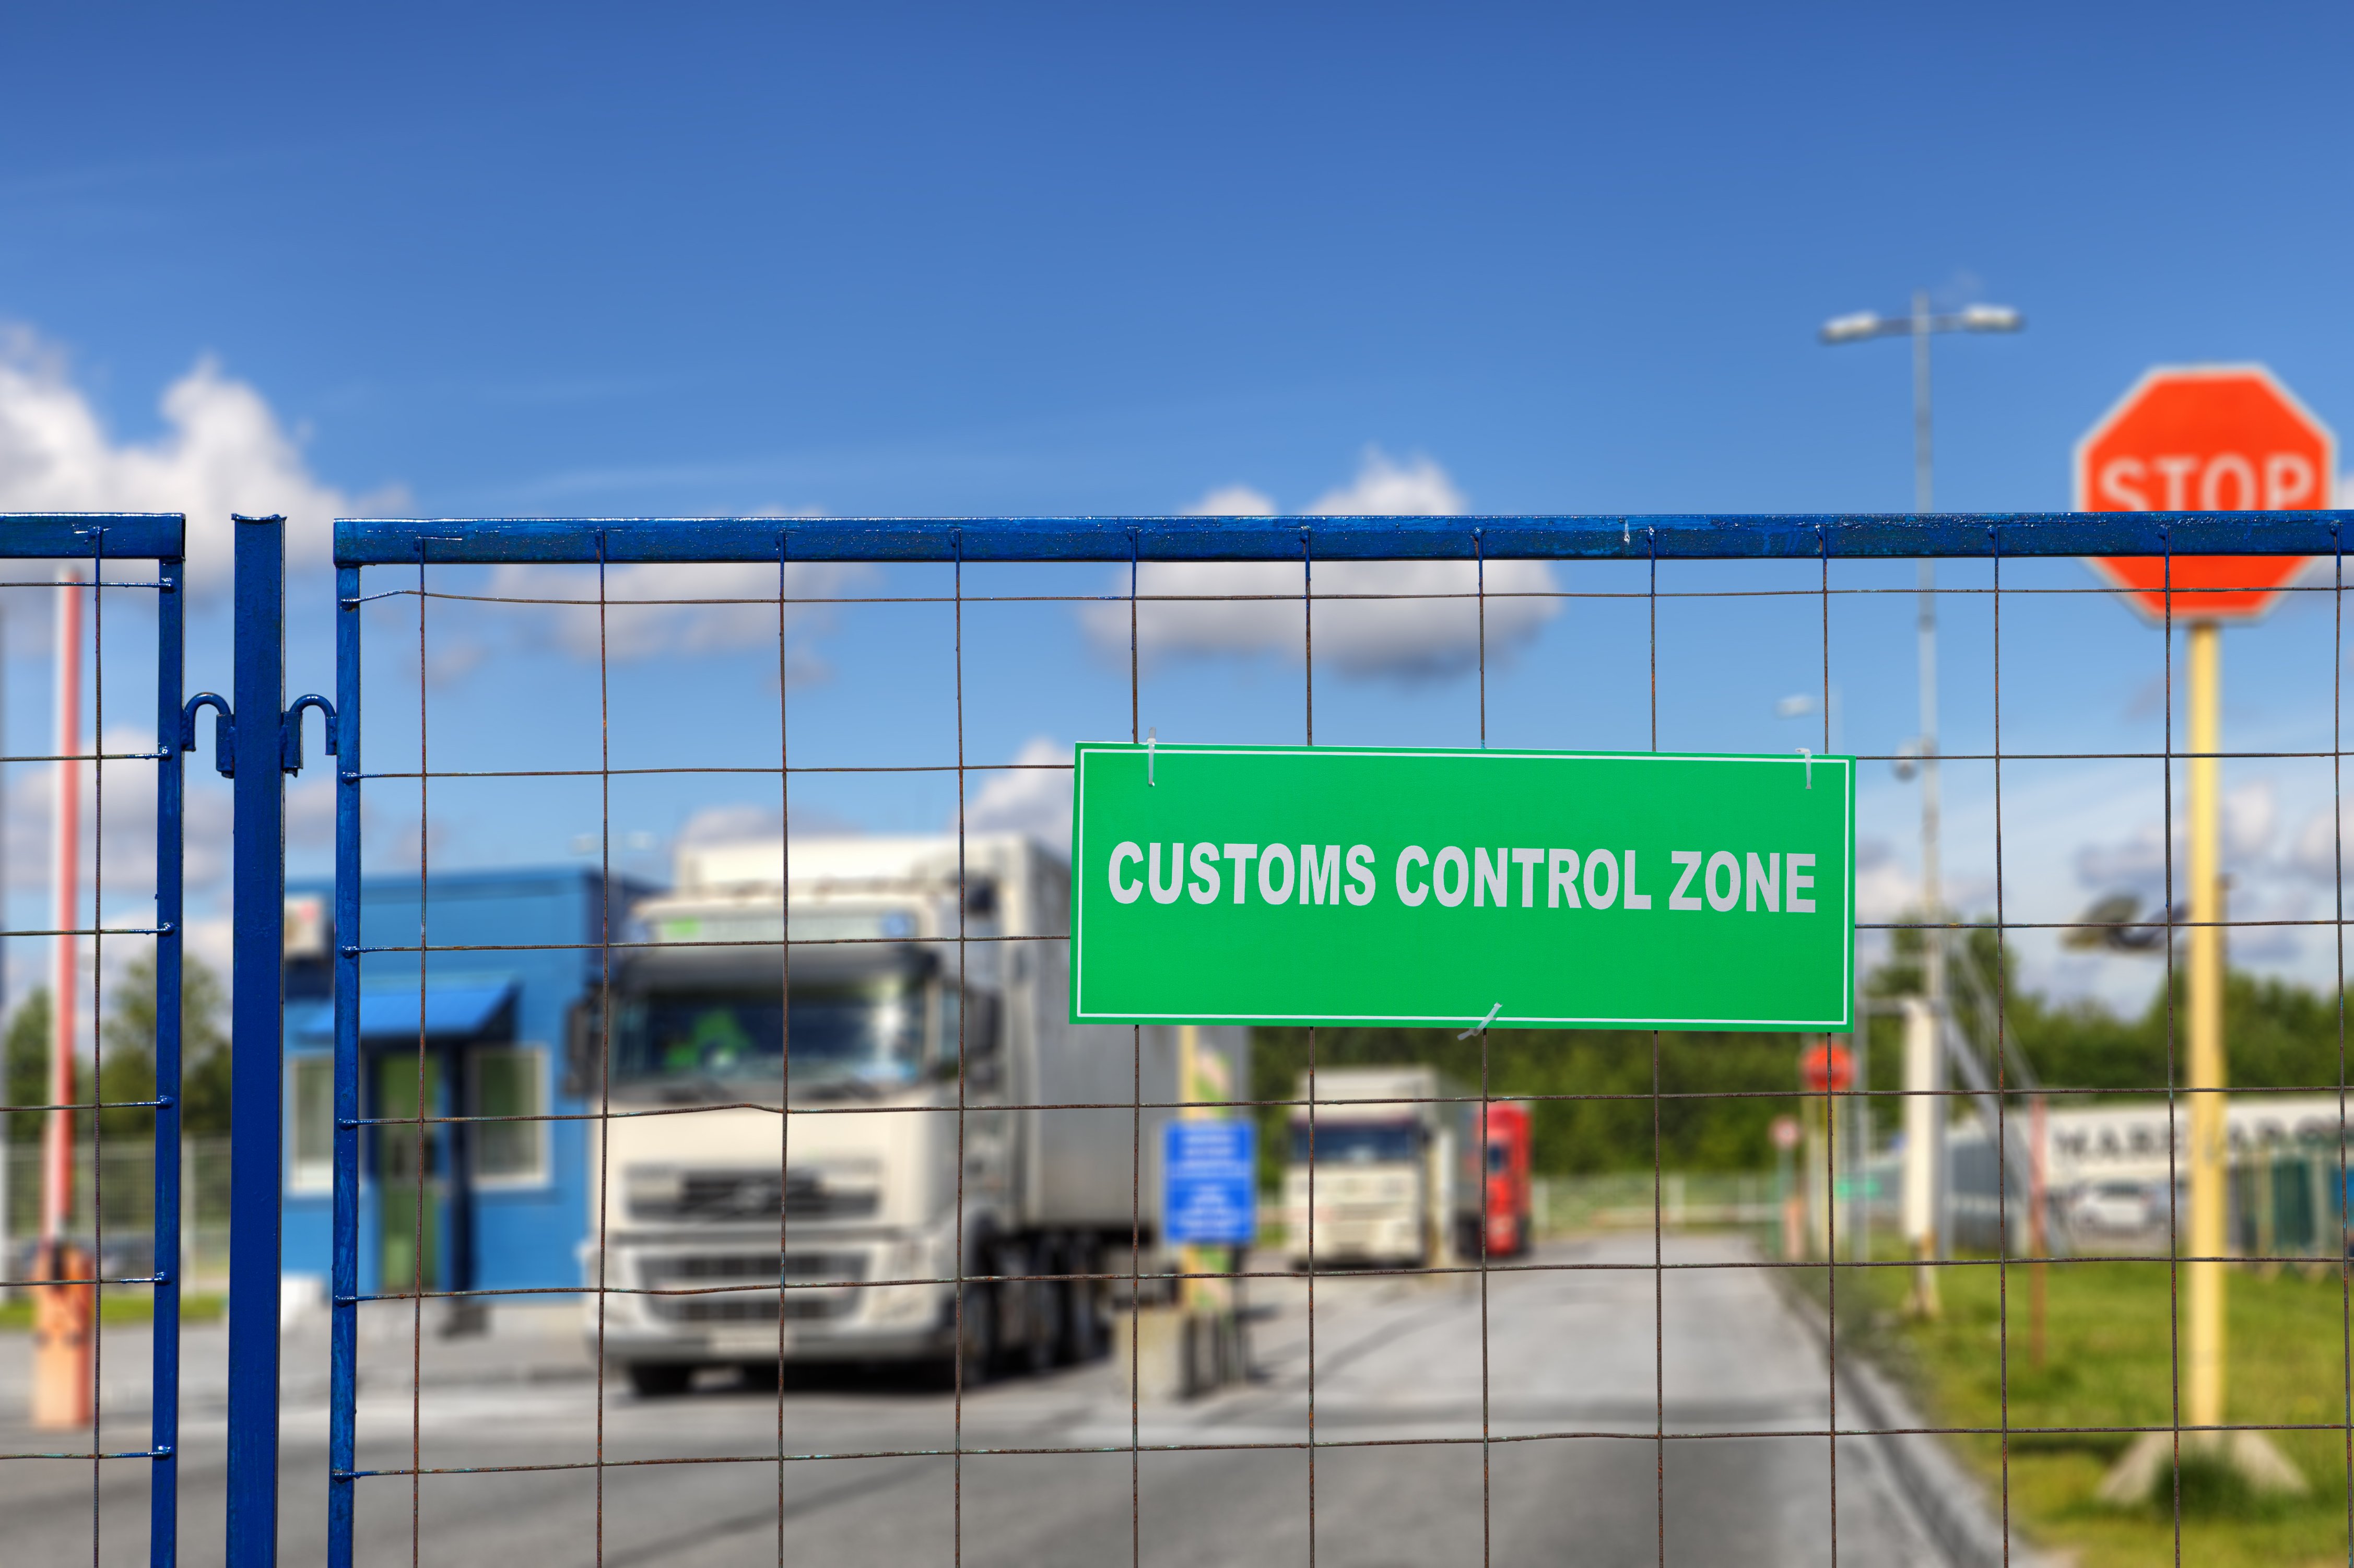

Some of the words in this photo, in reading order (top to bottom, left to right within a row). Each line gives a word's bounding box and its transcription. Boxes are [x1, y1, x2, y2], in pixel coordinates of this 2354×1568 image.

[2097, 452, 2315, 511] STOP
[1108, 841, 1376, 905] CUSTOMS
[1395, 845, 1652, 910] CONTROL
[1669, 851, 1816, 913] ZONE
